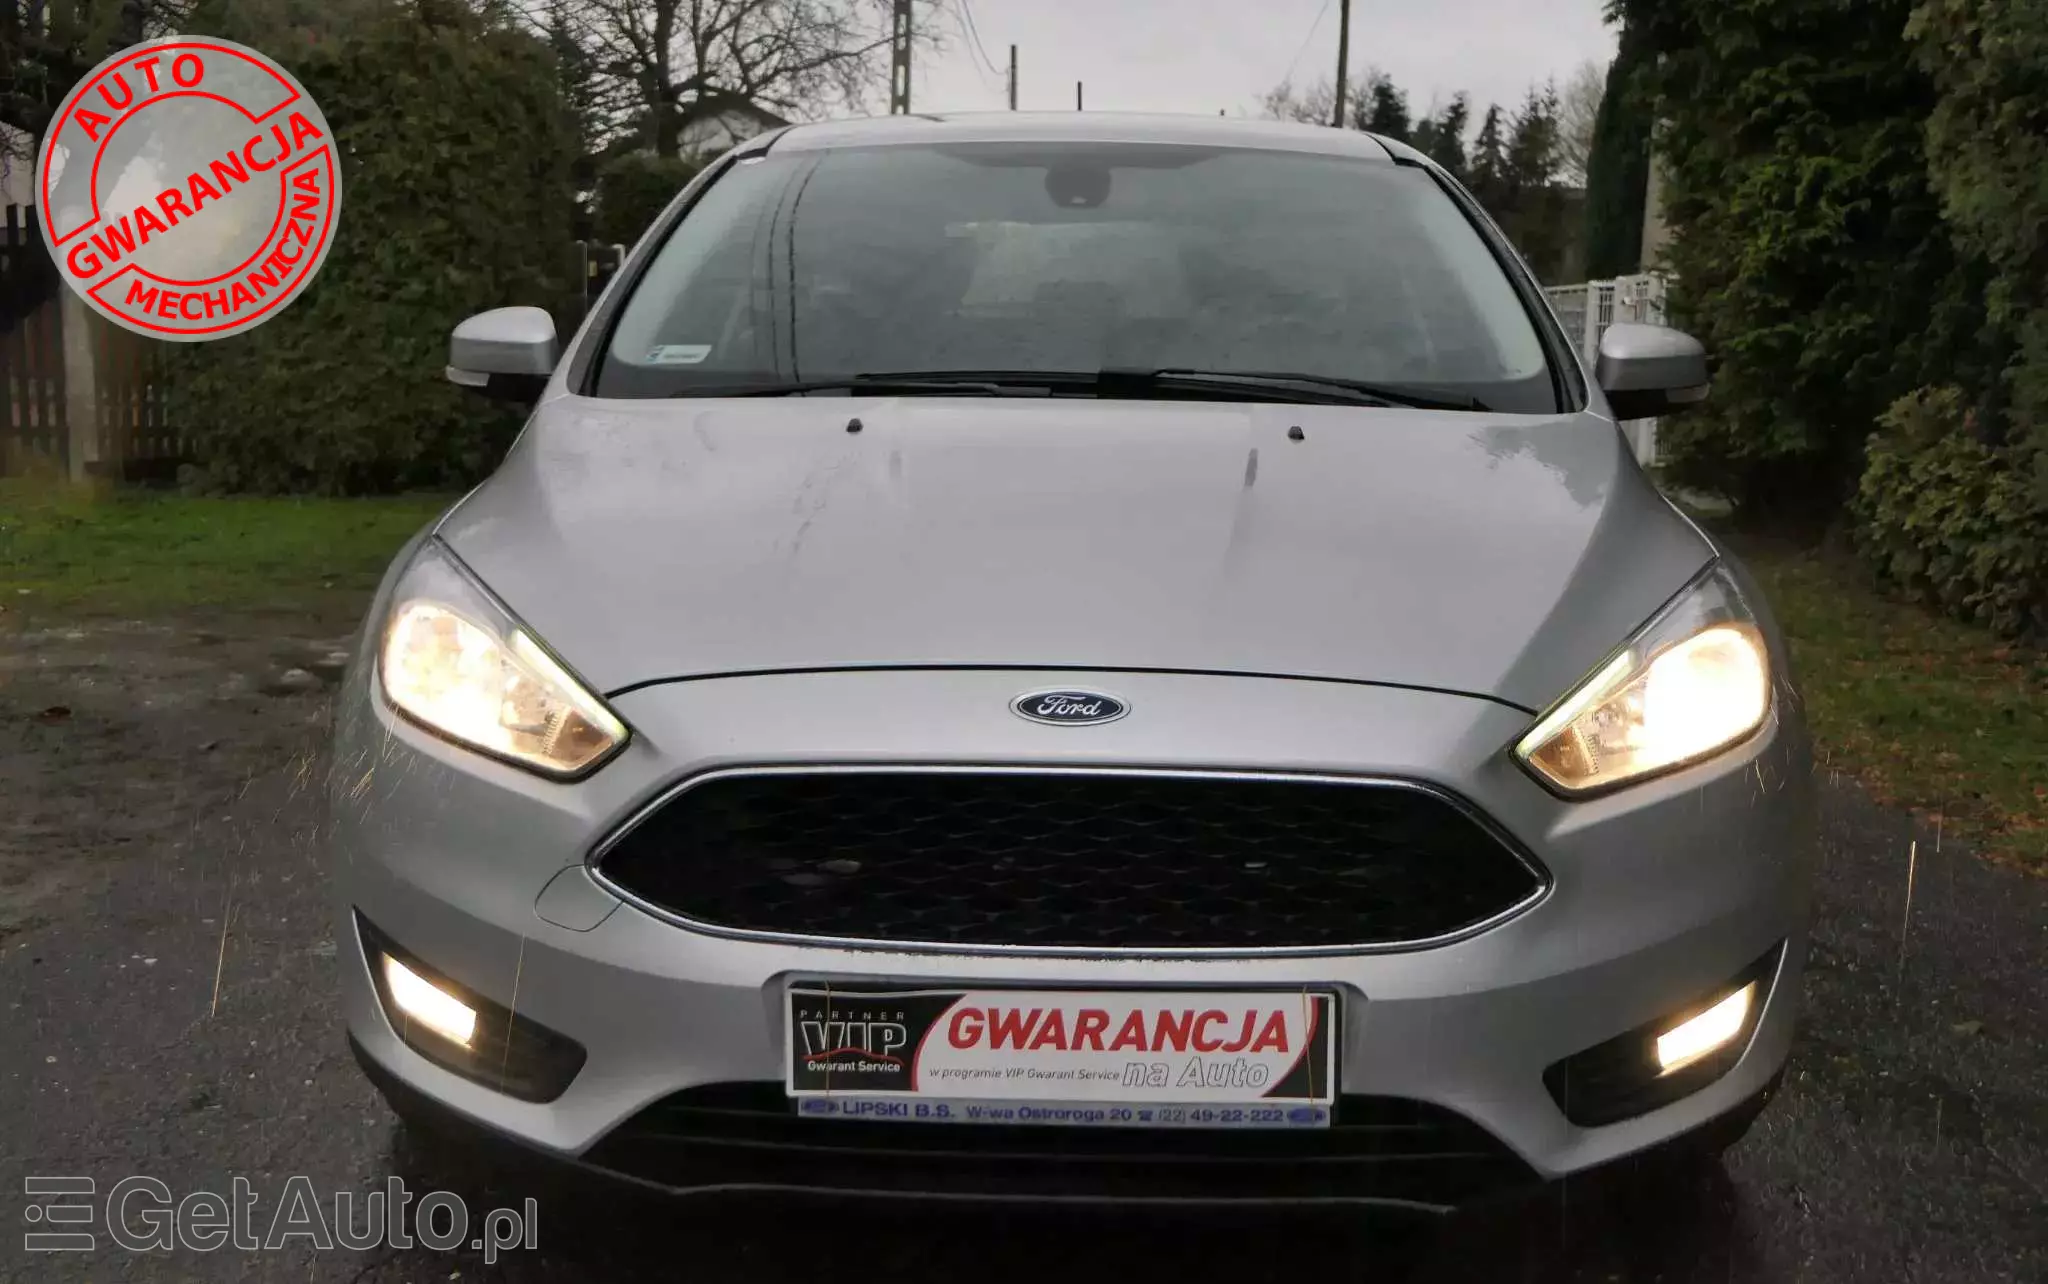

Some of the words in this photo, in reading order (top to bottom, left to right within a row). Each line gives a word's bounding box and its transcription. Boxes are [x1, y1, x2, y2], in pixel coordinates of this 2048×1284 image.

[1037, 695, 1102, 715] Ford
[800, 1010, 905, 1020] PARTNER
[800, 1021, 907, 1056] VIP
[948, 1007, 1288, 1053] GWARANCJA
[808, 1060, 856, 1072] Gwarant
[858, 1060, 901, 1073] Service
[942, 1066, 1001, 1080] programie
[1006, 1068, 1025, 1078] VIP
[1028, 1068, 1074, 1080] Gwarant
[1078, 1069, 1120, 1081] Service
[1121, 1060, 1169, 1088] na
[1176, 1055, 1270, 1089] Auto
[843, 1101, 908, 1116] LIPSKI
[915, 1103, 955, 1118] B.S.
[966, 1106, 1014, 1120] W-wa
[1018, 1106, 1105, 1123] Ostroroga
[1110, 1108, 1132, 1121] 20
[1158, 1107, 1187, 1124] (22)
[1190, 1108, 1283, 1122] 49-22-222
